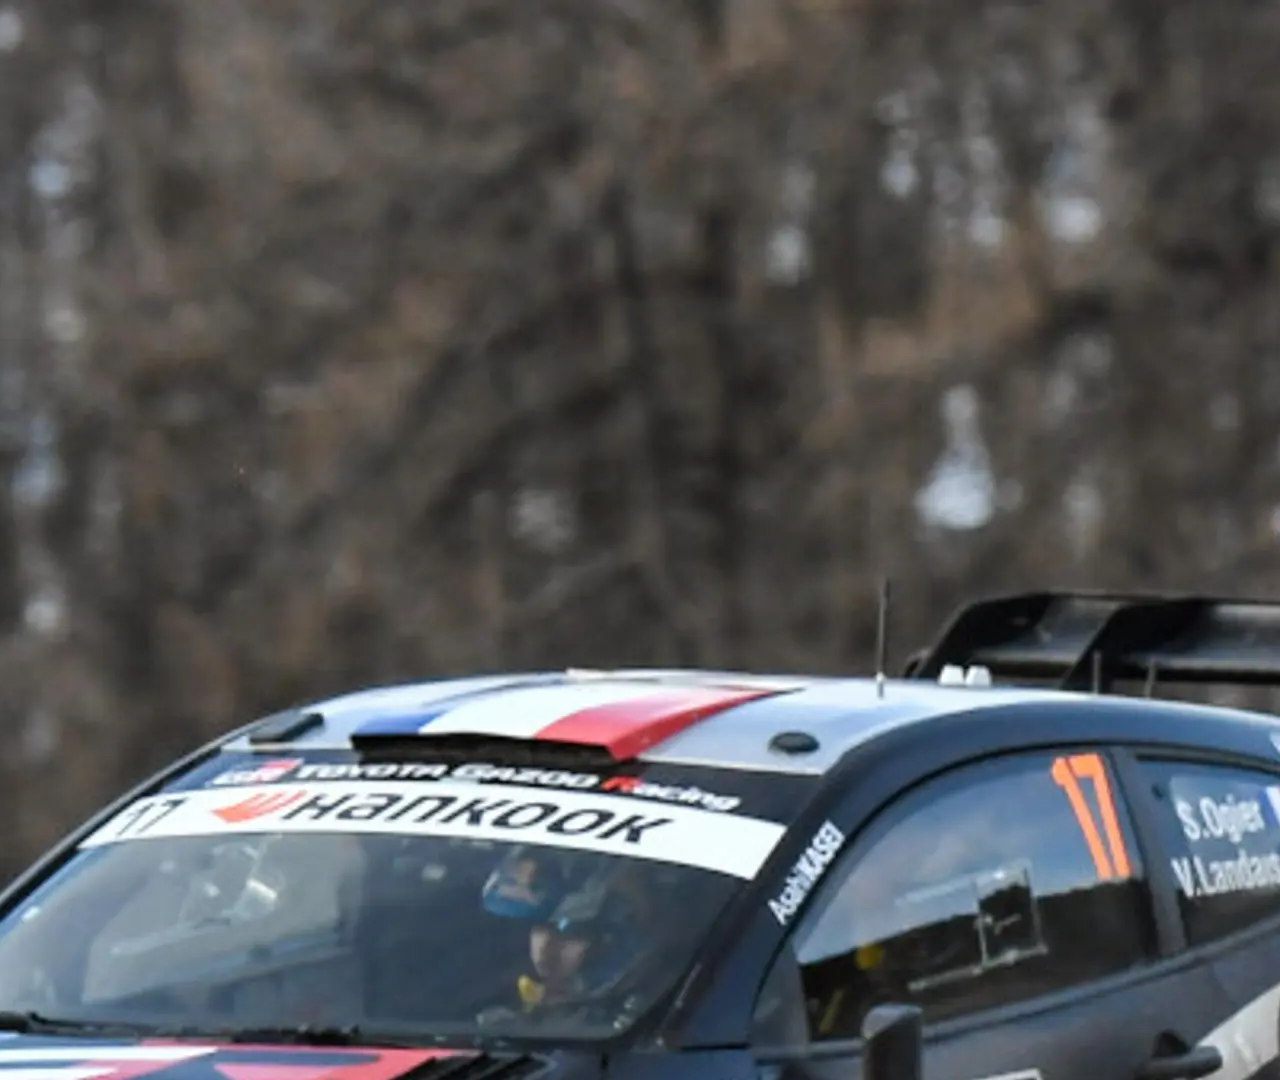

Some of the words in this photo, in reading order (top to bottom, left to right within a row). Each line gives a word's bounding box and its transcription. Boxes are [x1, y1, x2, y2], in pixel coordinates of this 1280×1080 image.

[297, 763, 448, 781] TOYOTA
[600, 775, 741, 813] Racing
[1051, 753, 1131, 880] 17
[1174, 796, 1266, 843] S.Ogier
